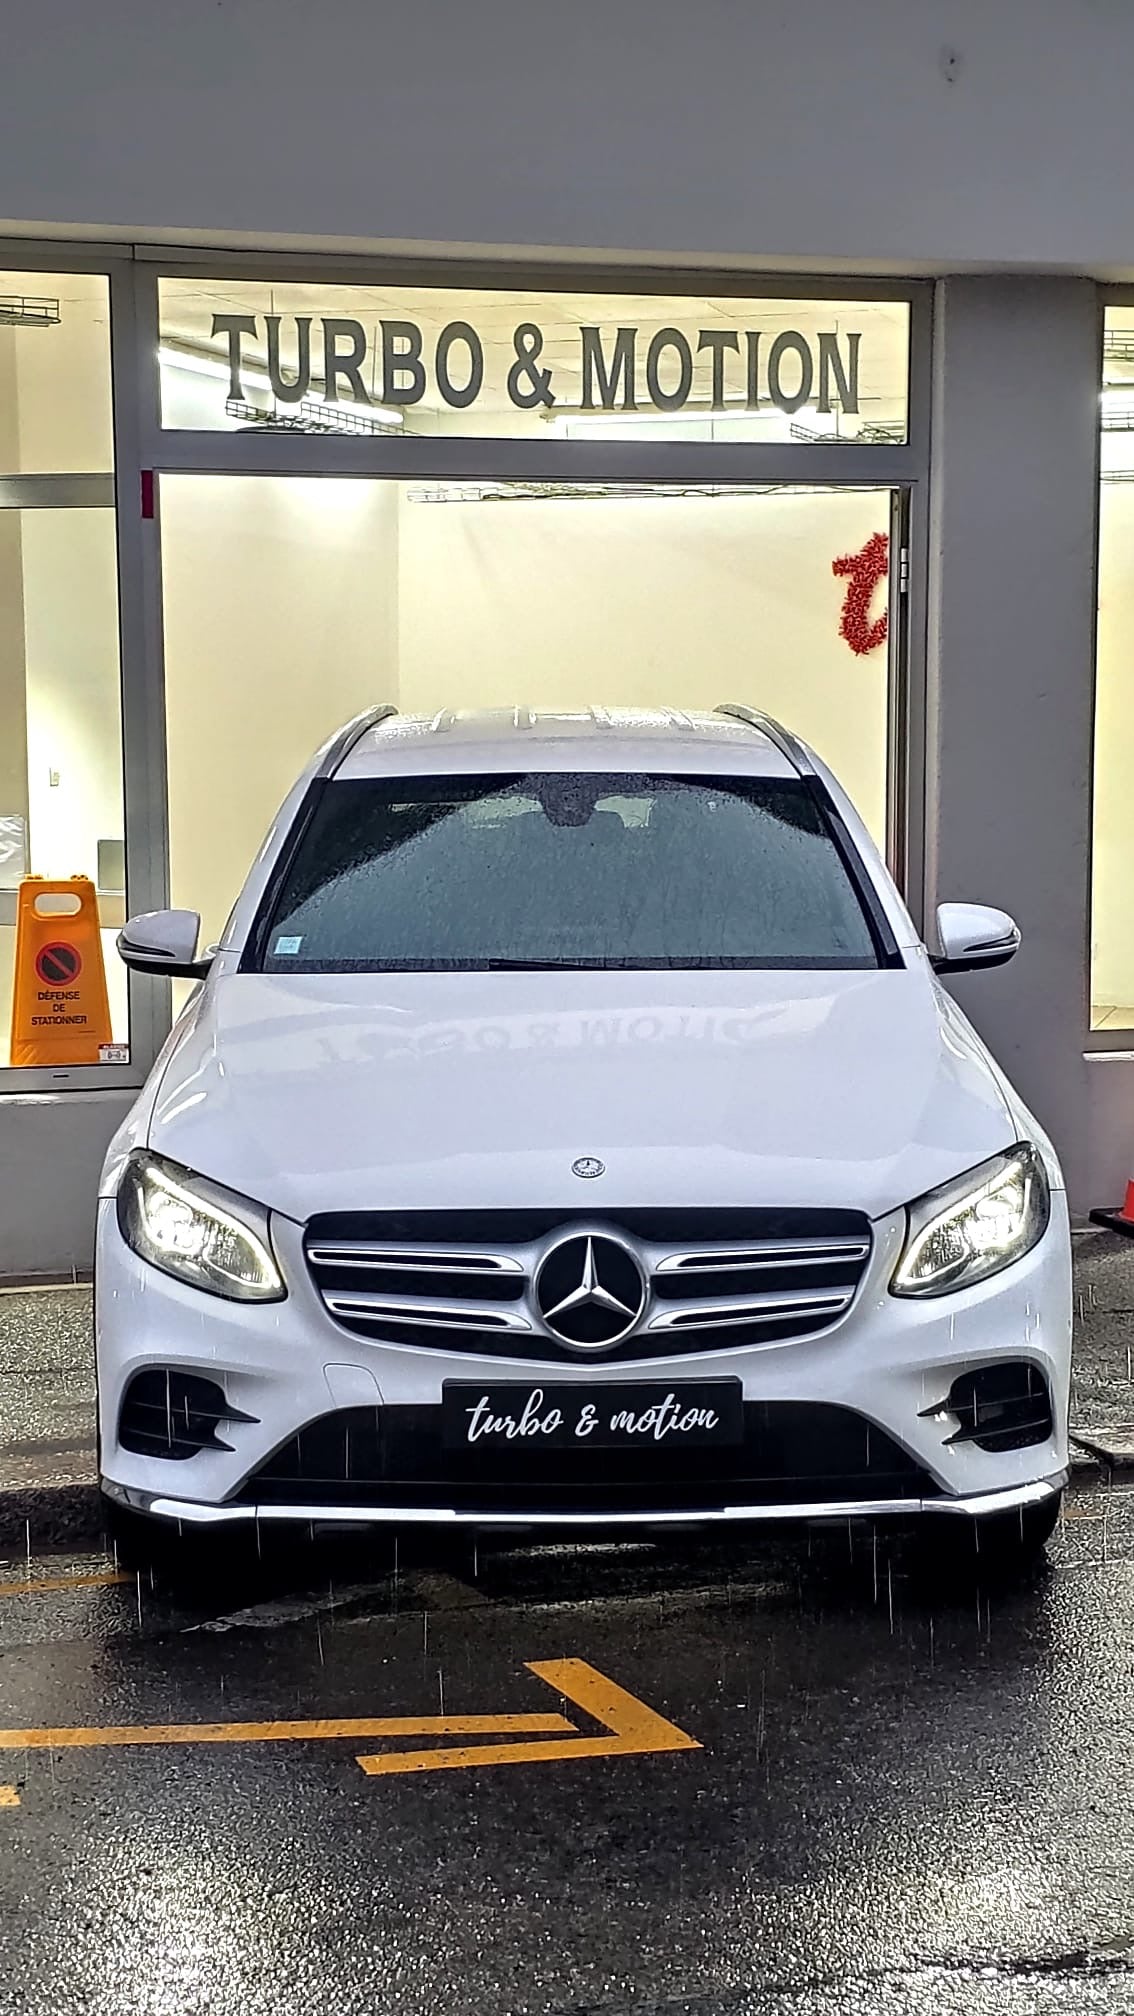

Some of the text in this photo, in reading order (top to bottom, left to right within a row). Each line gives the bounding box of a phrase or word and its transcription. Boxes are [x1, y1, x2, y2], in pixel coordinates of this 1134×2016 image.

[211, 313, 862, 414] TURBO & MOTION
[37, 990, 81, 1001] DÉFENSE
[52, 1003, 66, 1013] DE
[31, 1015, 87, 1026] STATIONNER
[465, 1388, 719, 1442] turbo & motion
